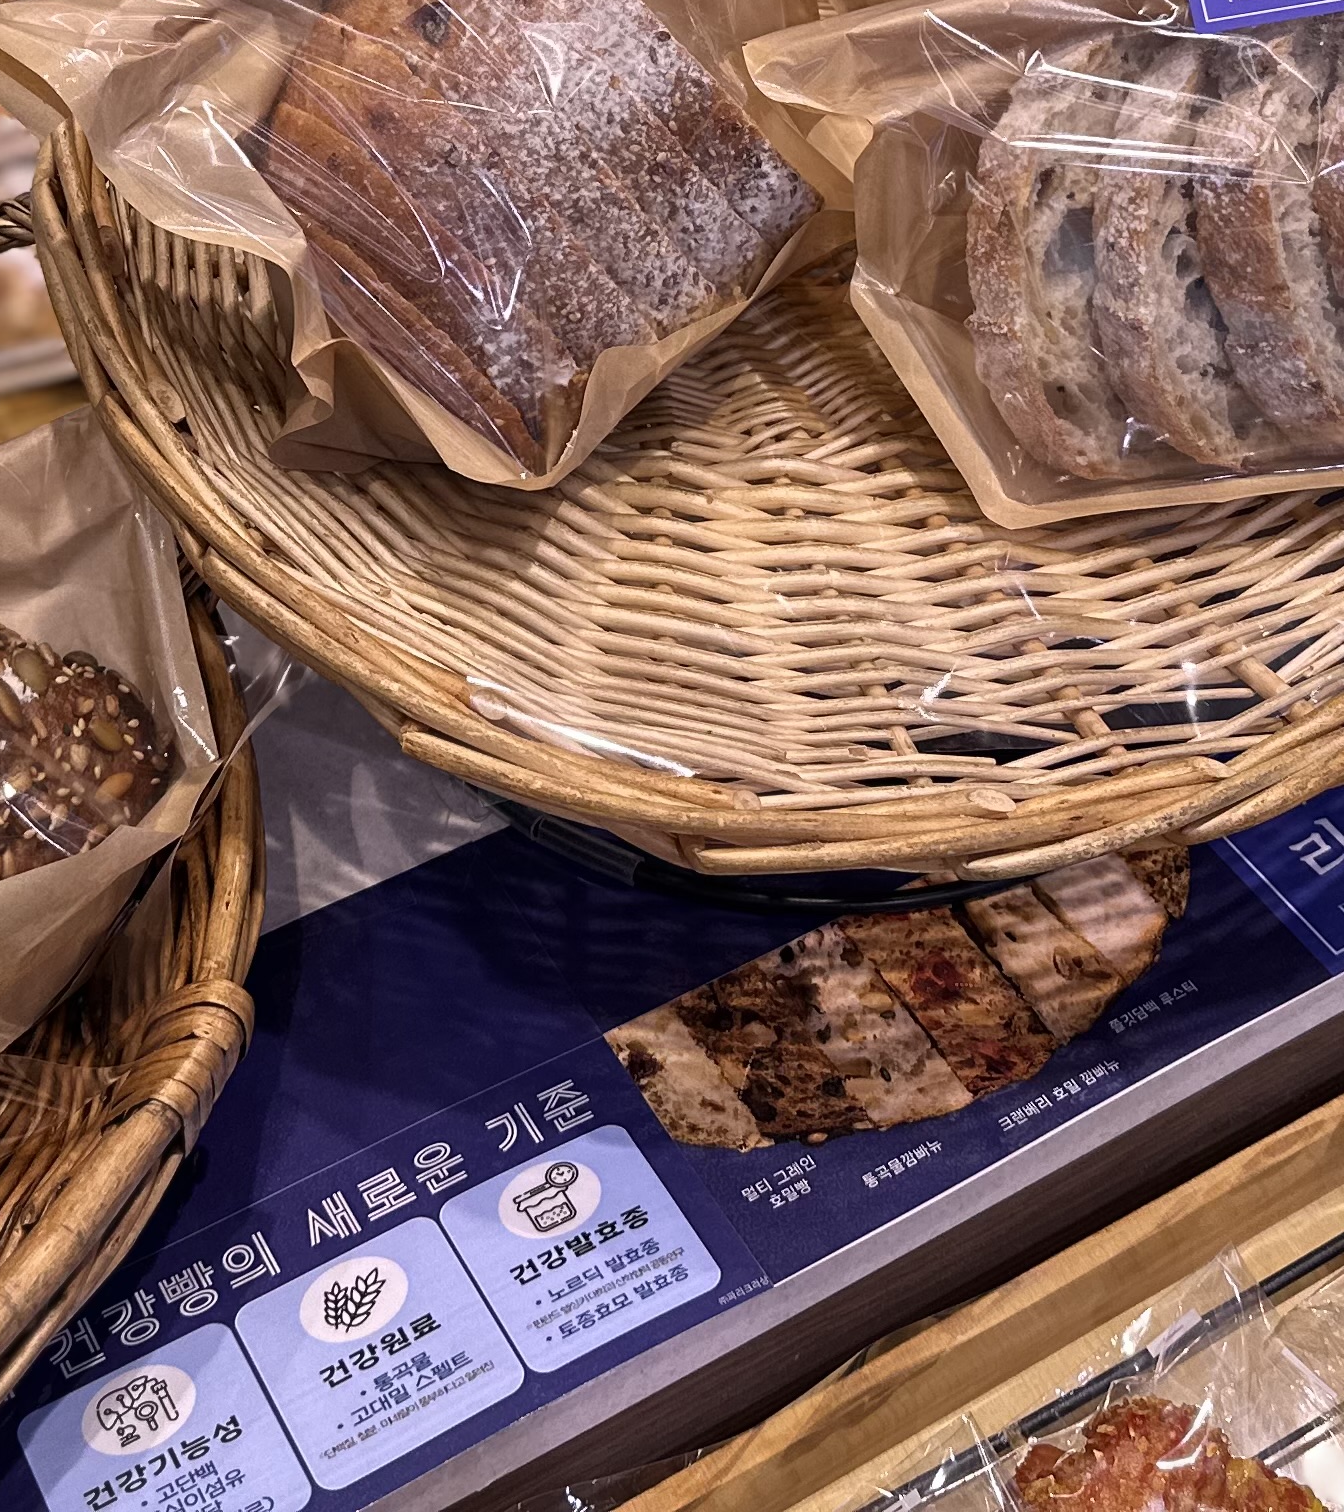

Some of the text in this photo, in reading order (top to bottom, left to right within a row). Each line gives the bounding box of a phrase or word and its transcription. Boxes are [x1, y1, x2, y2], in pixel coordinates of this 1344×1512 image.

[998, 1059, 1121, 1132] 크랜베리 호밀 깜빠뉴
[741, 1154, 817, 1204] 멀티 그레인
[768, 1178, 812, 1210] 호밀빵
[861, 1140, 943, 1189] 통곡물깜빠뉴
[49, 1079, 594, 1379] 건강빵의 새로운 기준
[509, 1206, 650, 1286] 건강발효종
[548, 1237, 662, 1305] 노르딕 발효종
[559, 1266, 691, 1338] 토종효모 발효종
[319, 1314, 441, 1388] 건강원료
[370, 1352, 436, 1391] 통곡물
[348, 1350, 476, 1426] 고대밀 스펠트
[83, 1415, 242, 1511] 건강기능성
[155, 1461, 219, 1503] 고단백
[155, 1469, 245, 1512] 식이섬유
